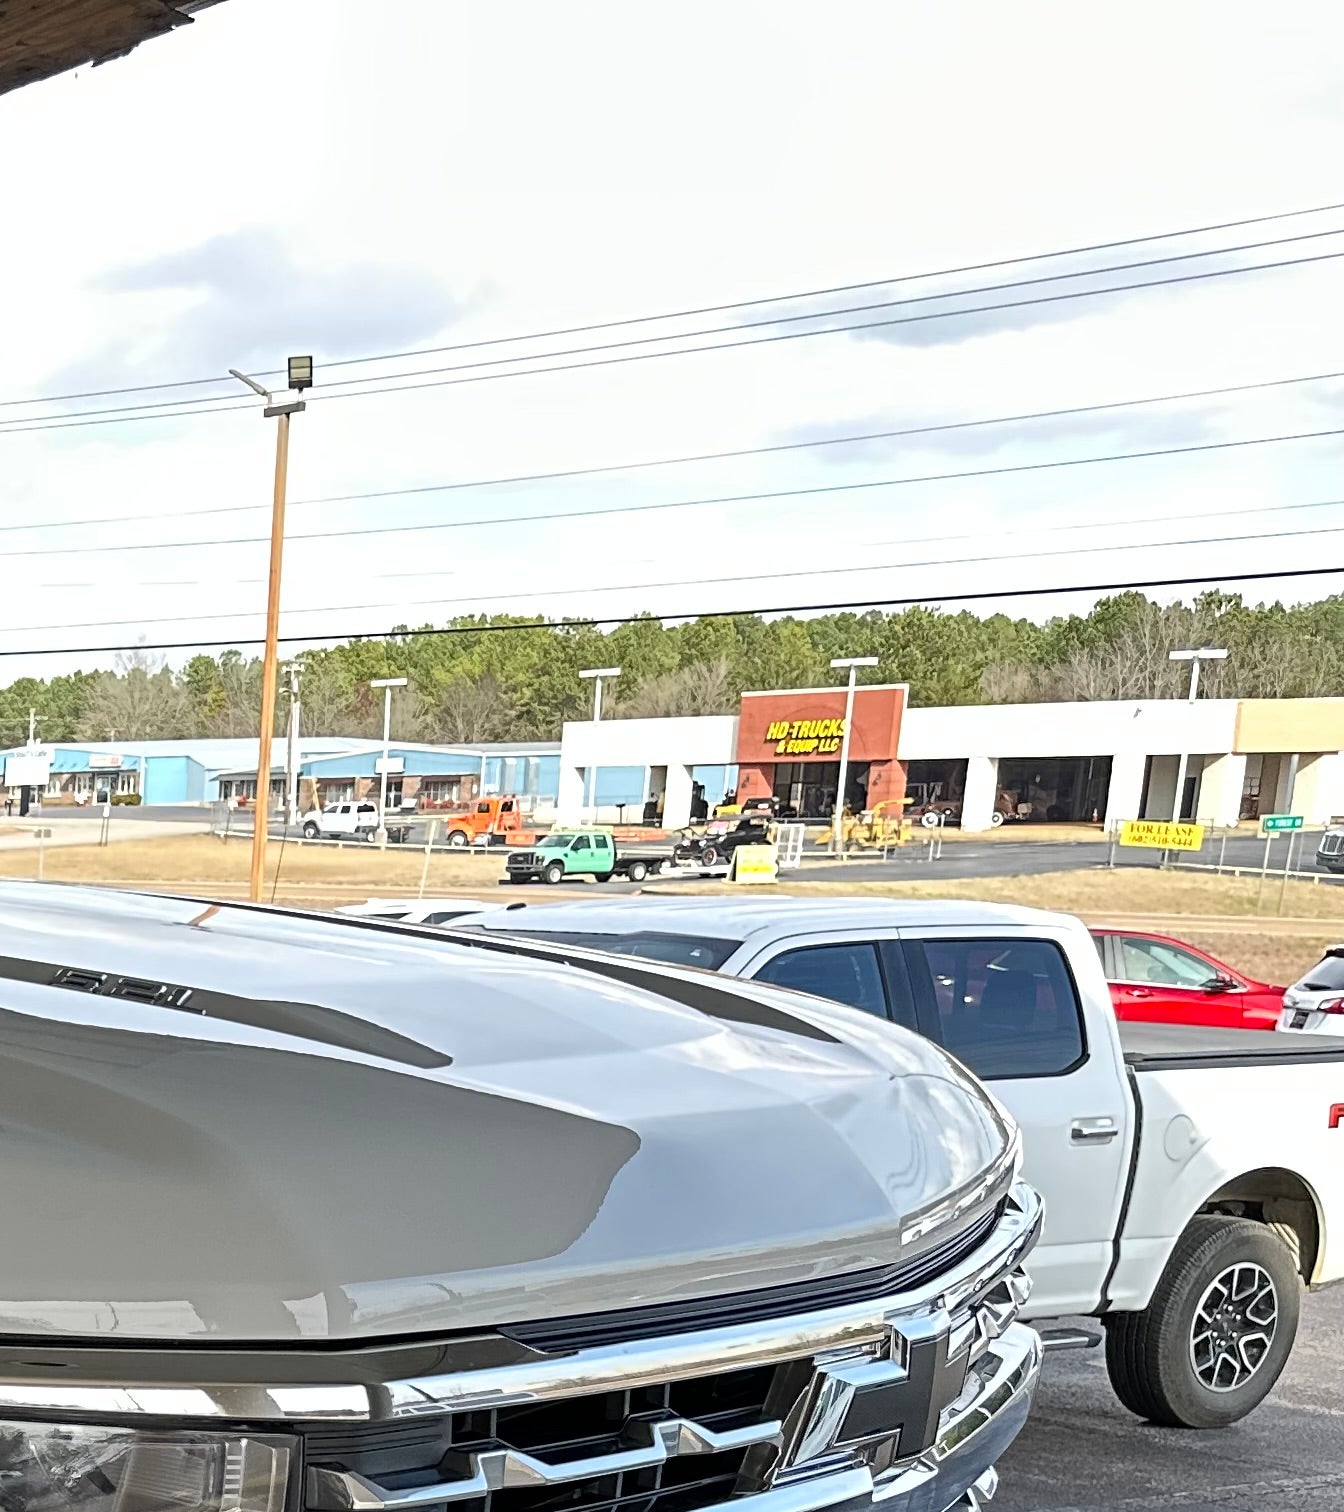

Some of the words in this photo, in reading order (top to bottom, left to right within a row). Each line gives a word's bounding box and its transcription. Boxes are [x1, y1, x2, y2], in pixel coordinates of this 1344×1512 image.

[818, 737, 840, 752] LLC
[1130, 822, 1154, 835] FOR
[1157, 825, 1194, 837] LEASE
